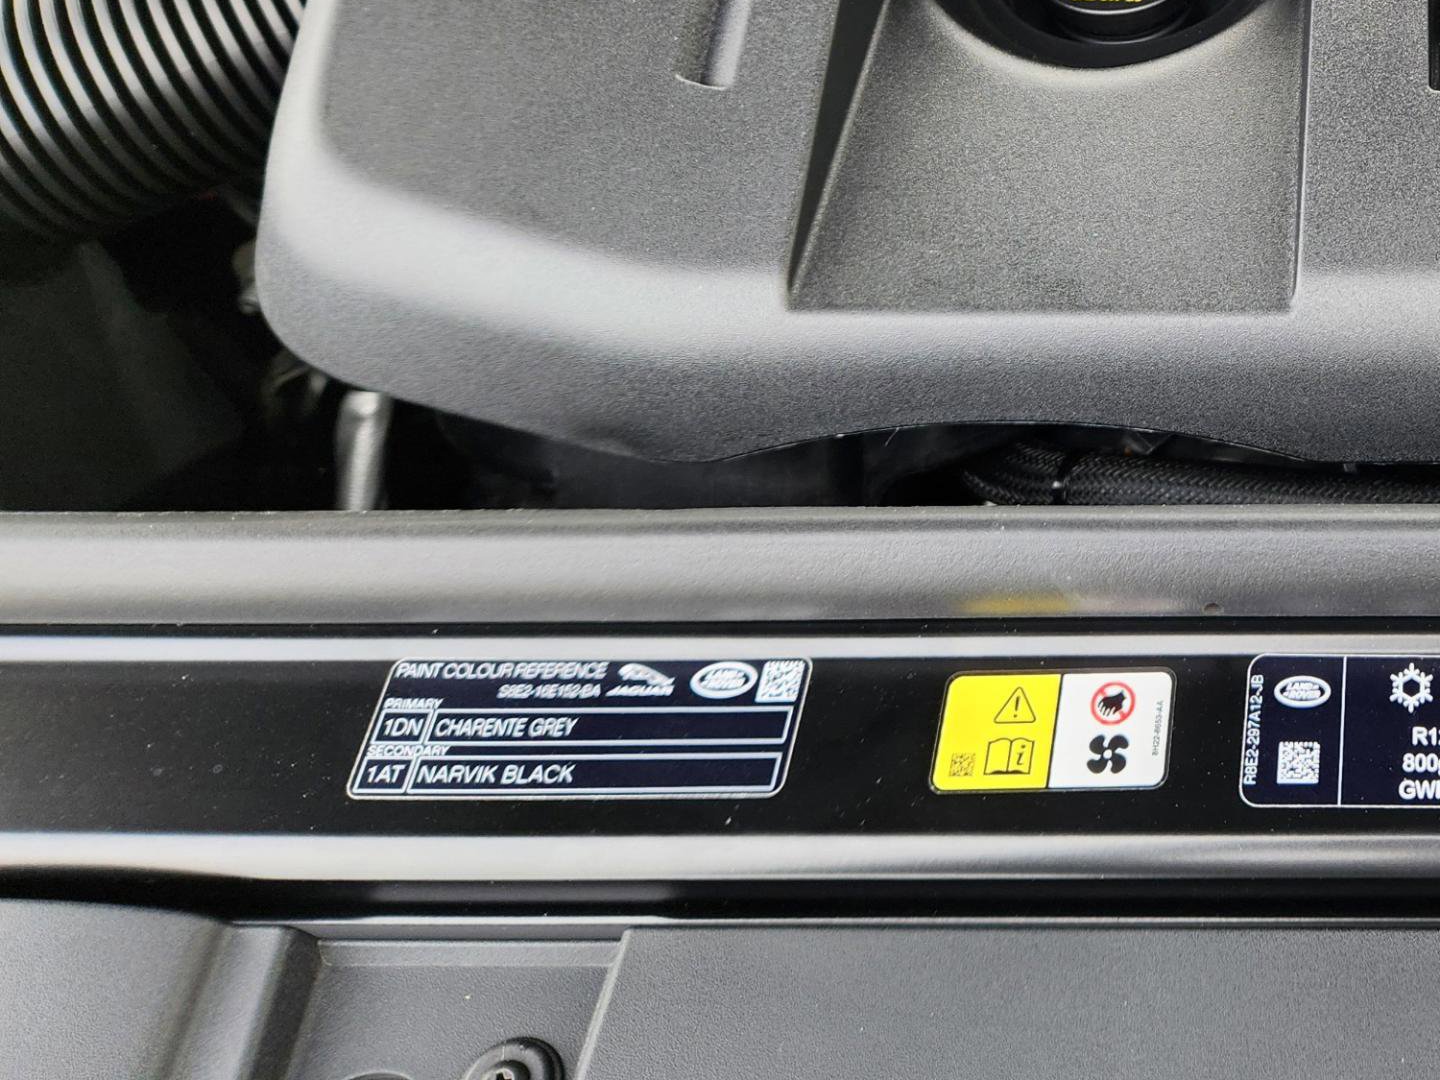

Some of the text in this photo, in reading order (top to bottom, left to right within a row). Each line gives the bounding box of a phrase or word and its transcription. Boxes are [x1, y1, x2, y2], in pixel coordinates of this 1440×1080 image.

[393, 661, 609, 679] PAINT COLOUR REFERENCE
[383, 697, 444, 710] PRIMARY
[384, 717, 579, 737] 1DN CHARENTE GREY
[367, 745, 450, 757] SECONDARY
[366, 765, 577, 785] 1AT NARVIK BLACK
